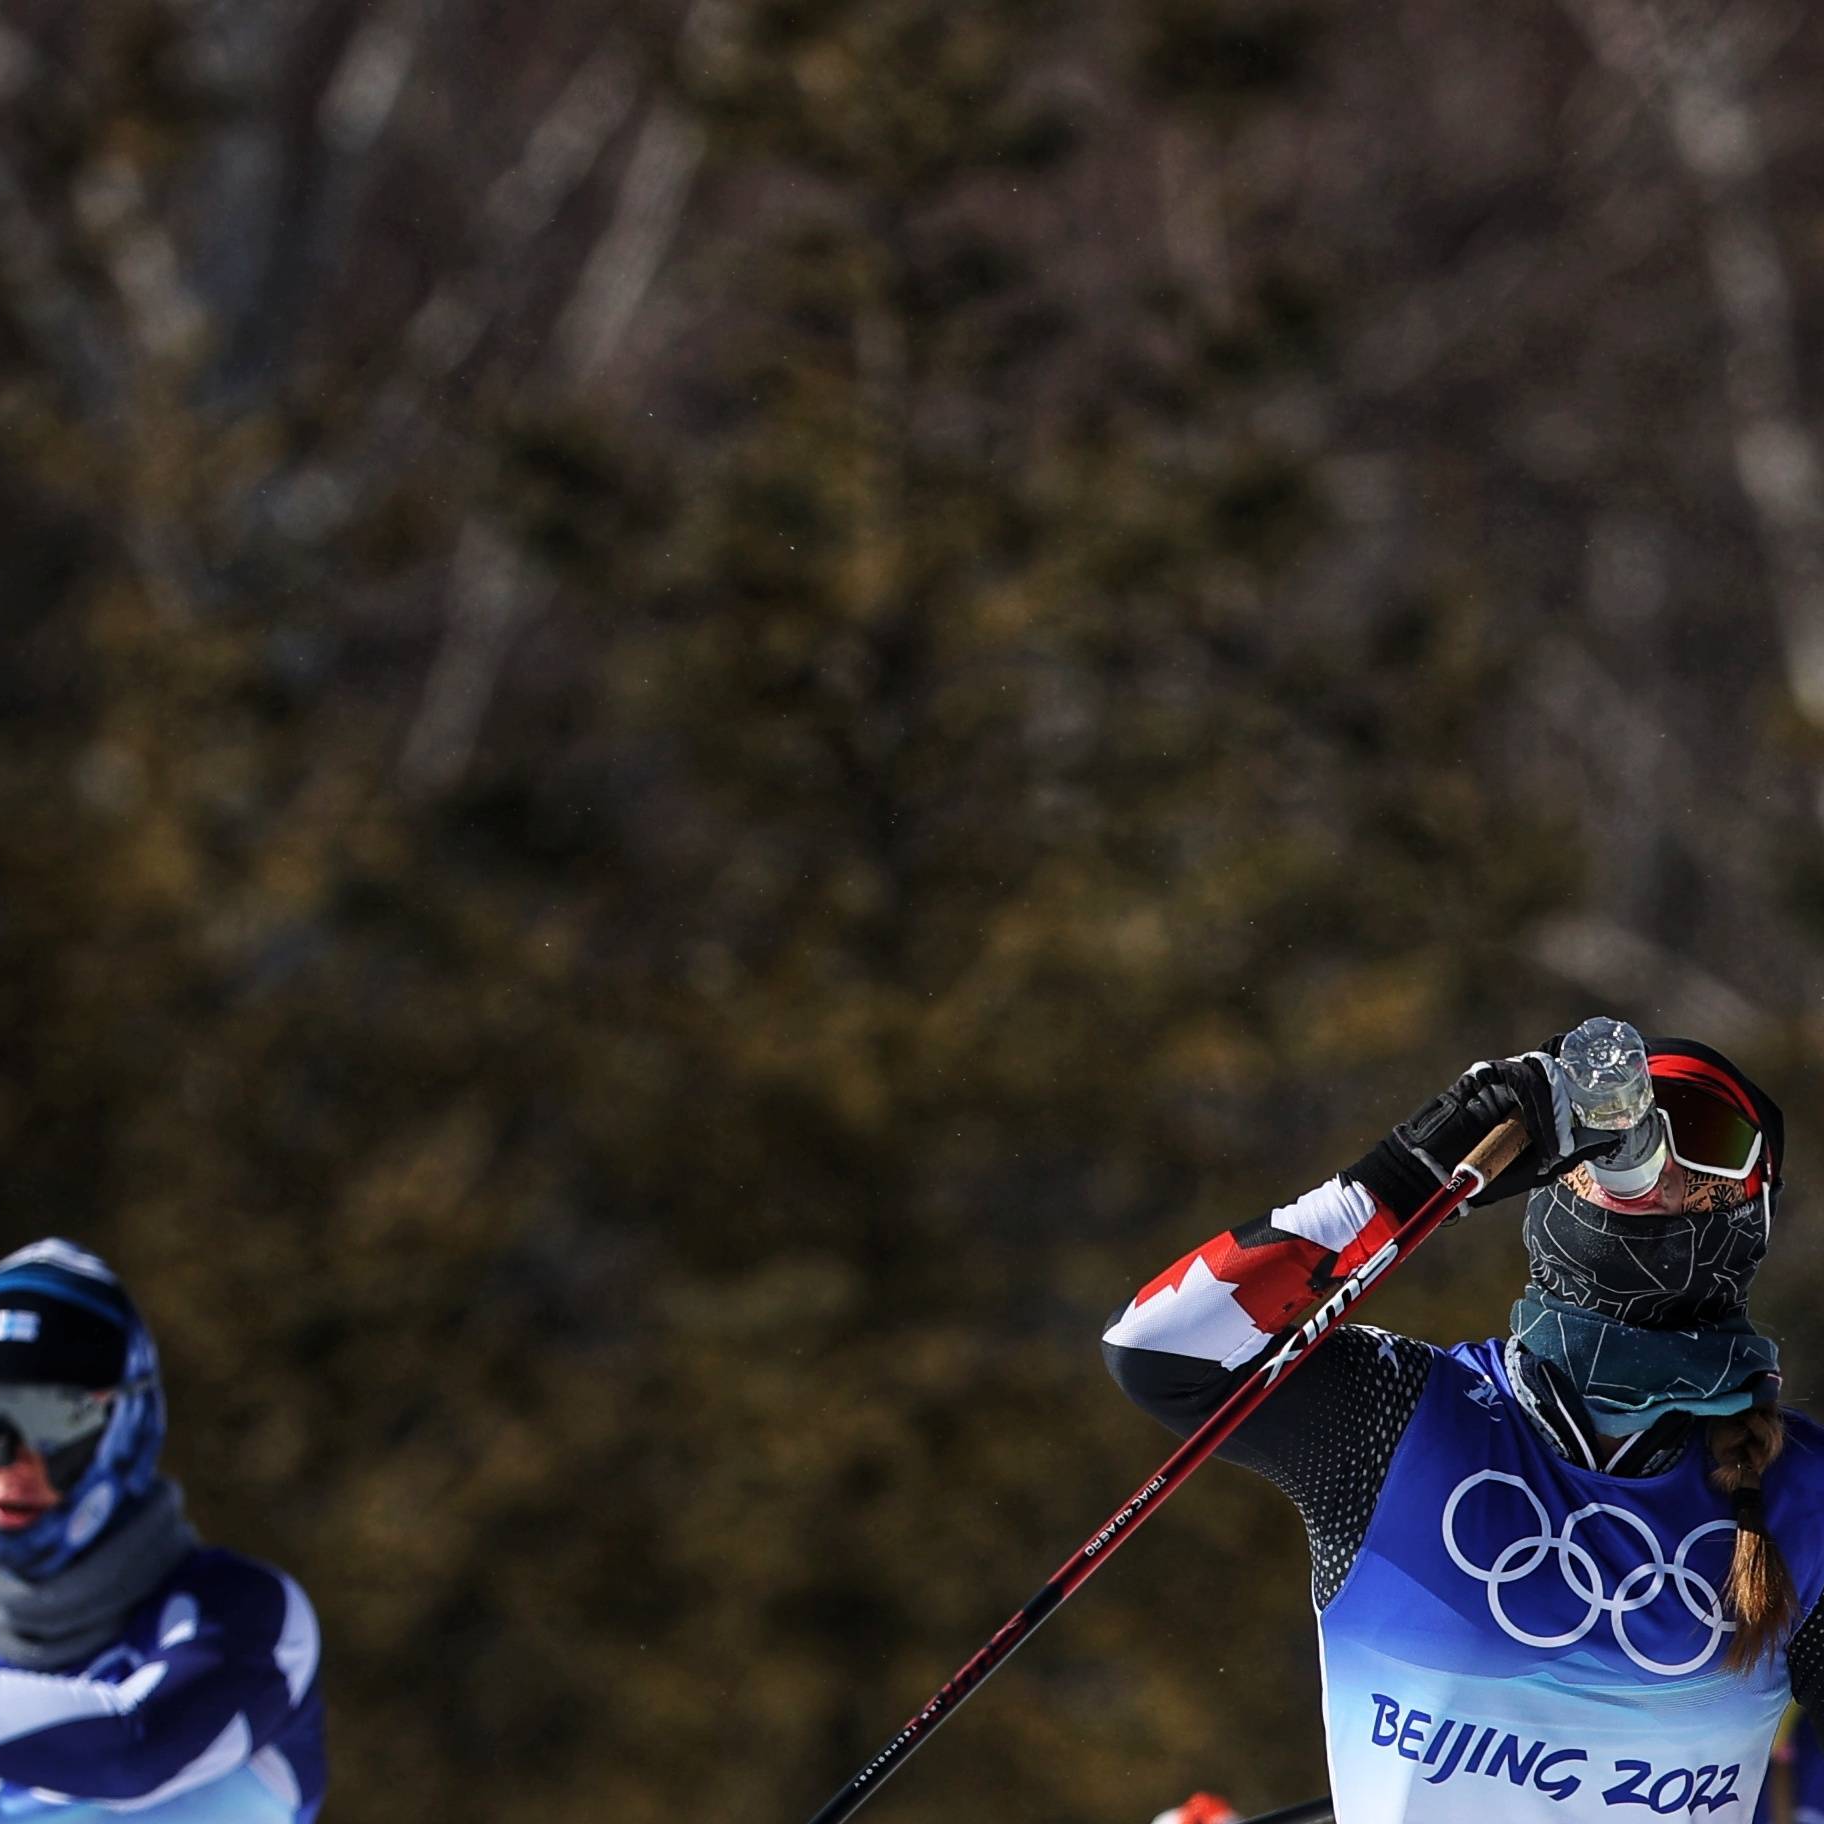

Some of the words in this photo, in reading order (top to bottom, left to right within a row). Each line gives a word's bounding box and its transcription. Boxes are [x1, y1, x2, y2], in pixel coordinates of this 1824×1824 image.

[1131, 1475, 1167, 1510] TRIAC
[1084, 1522, 1116, 1557] AERO
[1371, 1693, 1589, 1802] BEIJING
[1601, 1759, 1741, 1815] 2022
